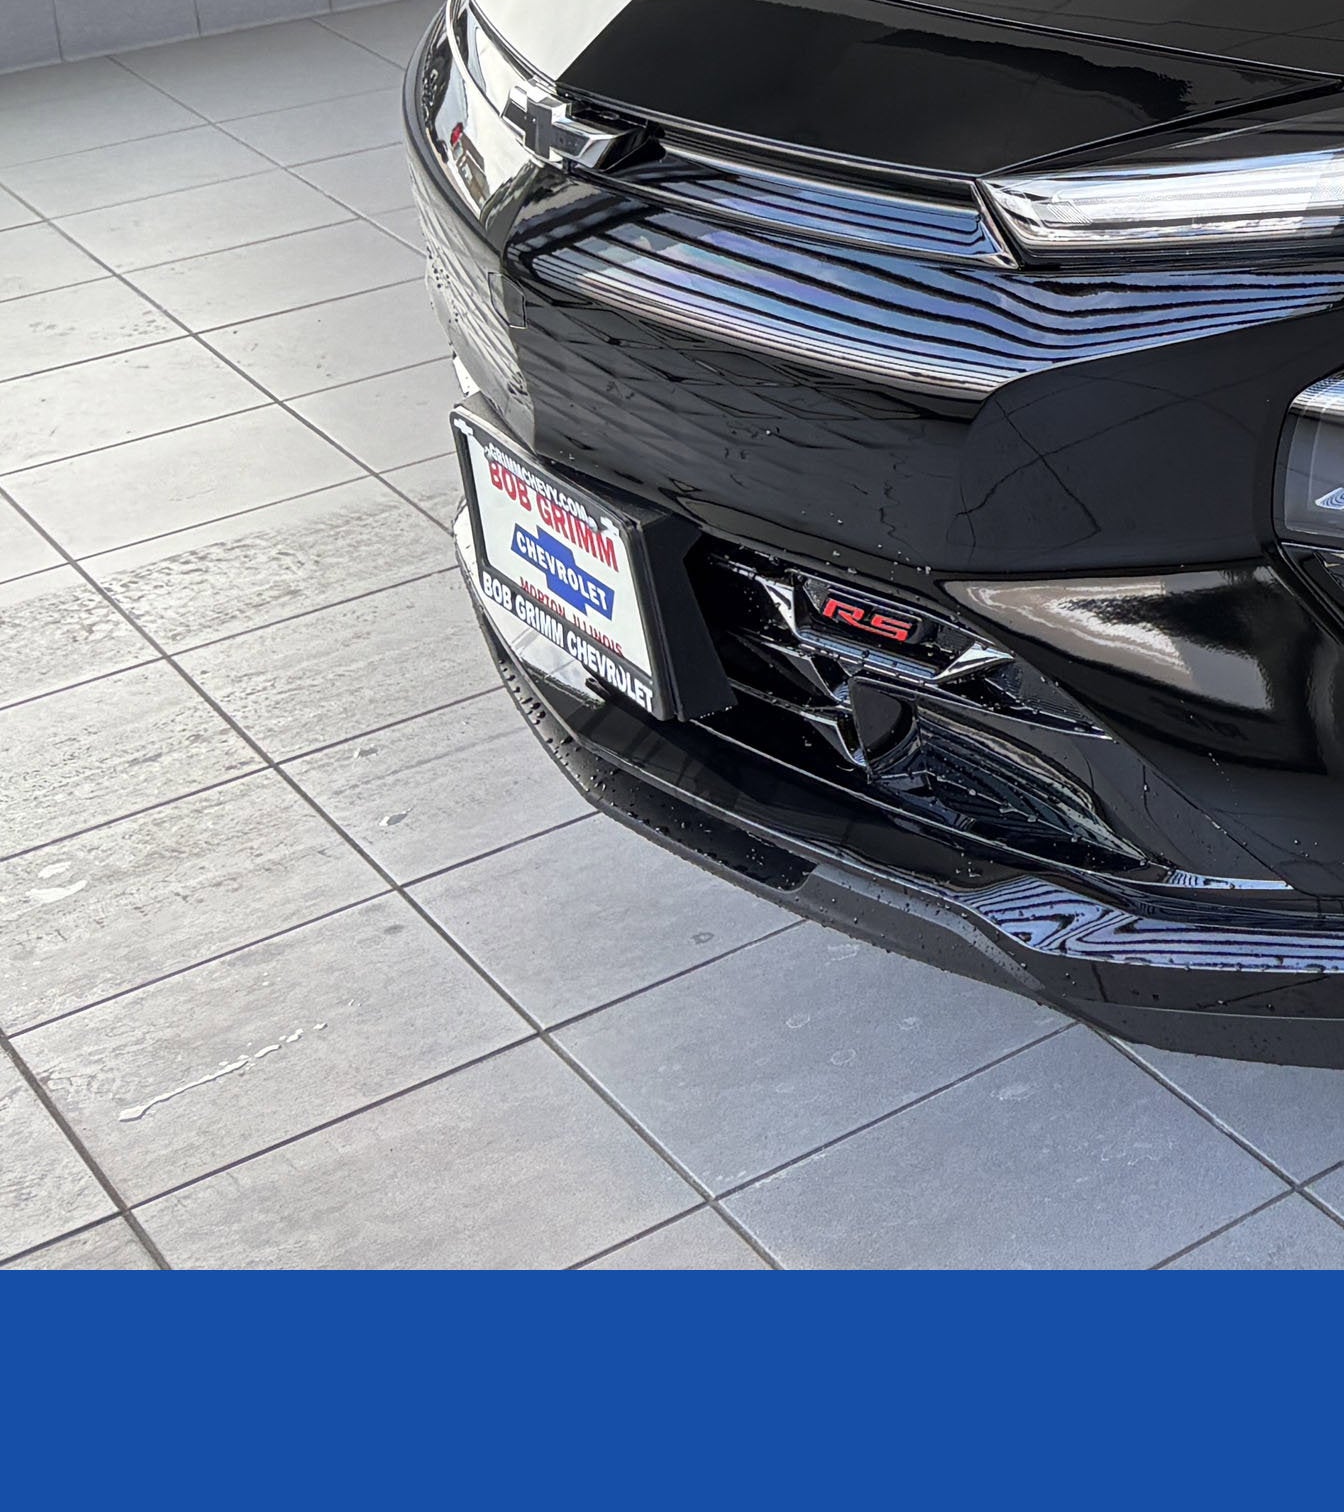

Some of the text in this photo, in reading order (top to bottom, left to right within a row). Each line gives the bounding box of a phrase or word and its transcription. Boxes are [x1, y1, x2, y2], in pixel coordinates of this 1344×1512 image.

[488, 442, 588, 523] GRIMMCHEVY.COM
[489, 460, 532, 512] BOB
[516, 532, 609, 612] CHEVROLET
[536, 491, 619, 573] GRIMM
[482, 571, 654, 713] BOB GRIMM CHEVROLET
[823, 597, 912, 642] RS
